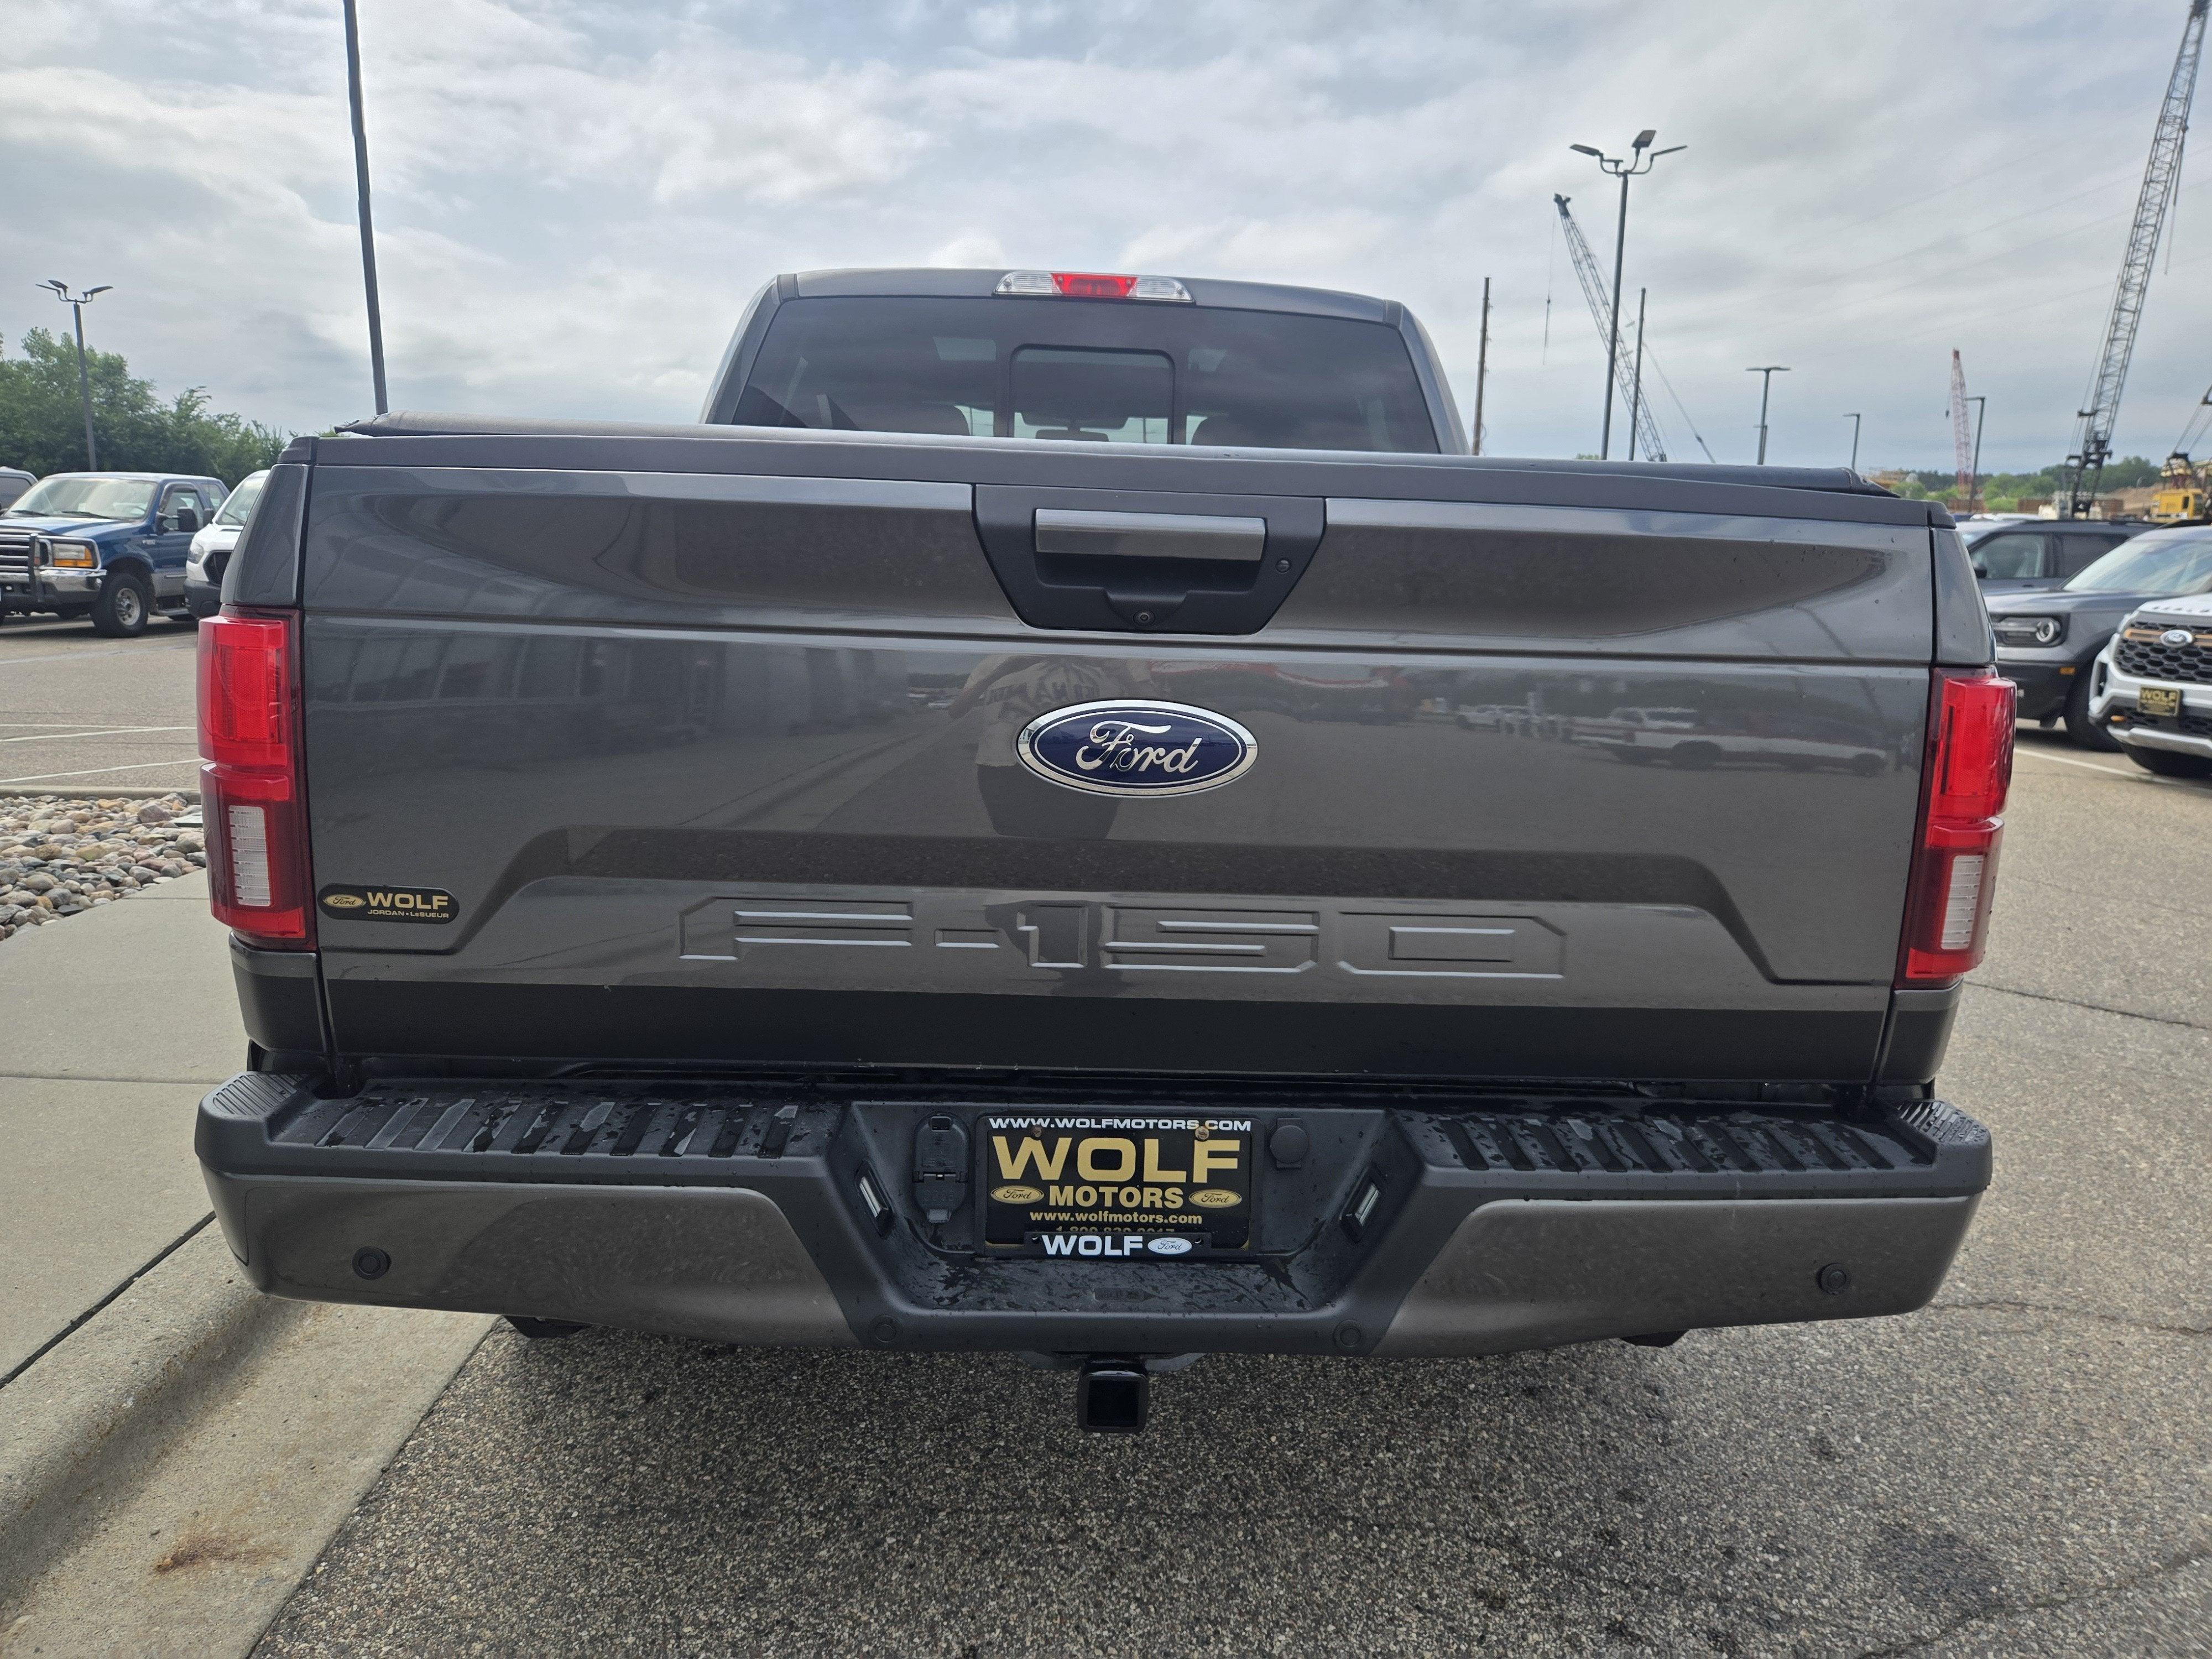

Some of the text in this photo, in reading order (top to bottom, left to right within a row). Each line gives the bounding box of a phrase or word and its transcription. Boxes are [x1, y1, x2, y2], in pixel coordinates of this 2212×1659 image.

[1076, 720, 1203, 773] Ford
[332, 896, 356, 905] Ford
[367, 892, 448, 910] WOLF
[678, 896, 1567, 978] F-150
[989, 1118, 1251, 1131] WWW.WOLFMOTORSCOM
[992, 1136, 1240, 1183] WOLF
[1003, 1188, 1032, 1199] Ford
[1049, 1186, 1183, 1209] MOTORS
[1201, 1192, 1229, 1203] Ford
[1030, 1209, 1203, 1224] www.wolfmotors.com
[1041, 1235, 1143, 1256] WOLF
[1157, 1240, 1182, 1250] Ford
